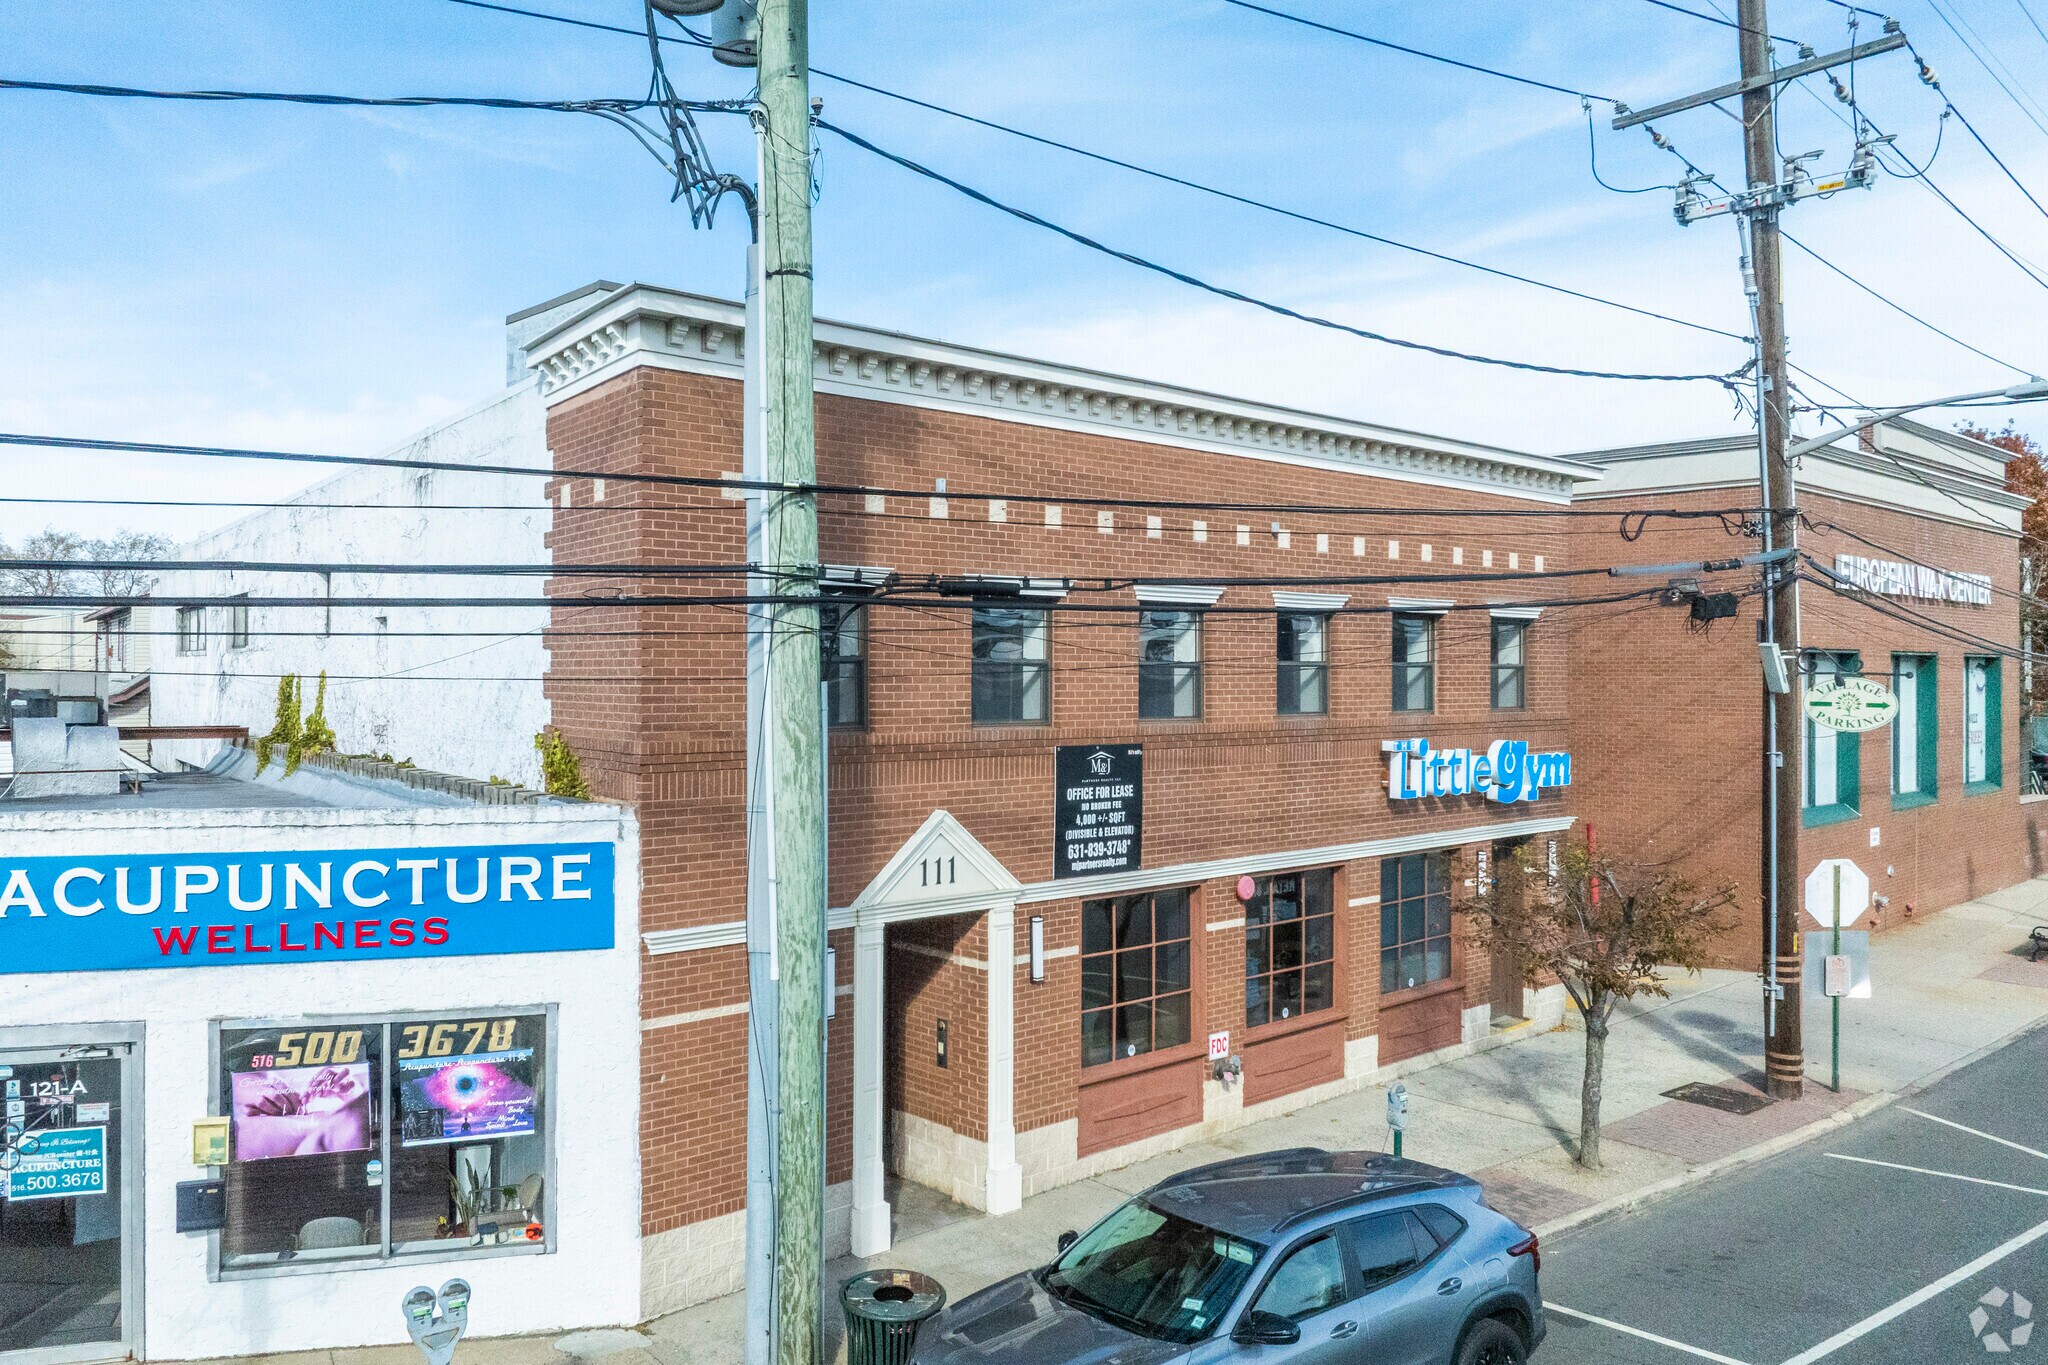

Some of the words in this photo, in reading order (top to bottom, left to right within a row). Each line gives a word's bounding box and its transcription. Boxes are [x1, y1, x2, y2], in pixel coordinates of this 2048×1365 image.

[1836, 554, 1915, 596] EUROPEAN
[1917, 564, 1947, 600] WAX
[1949, 571, 1992, 604] CENTER
[1815, 711, 1885, 729] PARKING
[1393, 739, 1416, 752] THE
[1091, 758, 1111, 775] M&J
[1396, 738, 1492, 799] Little
[1067, 787, 1093, 801] OFFICE
[1095, 786, 1110, 799] FOR
[1111, 785, 1133, 798] LEASE
[1081, 803, 1090, 811] NO
[1091, 801, 1111, 811] BROKER
[1112, 801, 1122, 809] FEE
[1076, 814, 1096, 826] 4,000
[1097, 813, 1108, 823] +/-
[1109, 811, 1125, 824] SQFT
[1065, 828, 1097, 840] (DIVISIBLE
[1098, 827, 1103, 837] &
[1104, 825, 1134, 837] ELEVATOR)
[920, 856, 955, 886] 111
[0, 852, 592, 920] ACUPUNCTURE
[152, 917, 451, 956] WELLNESS
[251, 1054, 274, 1068] 516
[275, 1030, 363, 1067] 500
[398, 1018, 516, 1058] 3678
[1211, 1036, 1227, 1055] FDC
[30, 1080, 88, 1097] 121-A
[497, 1114, 516, 1122] Mind
[507, 1106, 525, 1114] Body
[11, 1159, 102, 1173] ACUPUNCTURE
